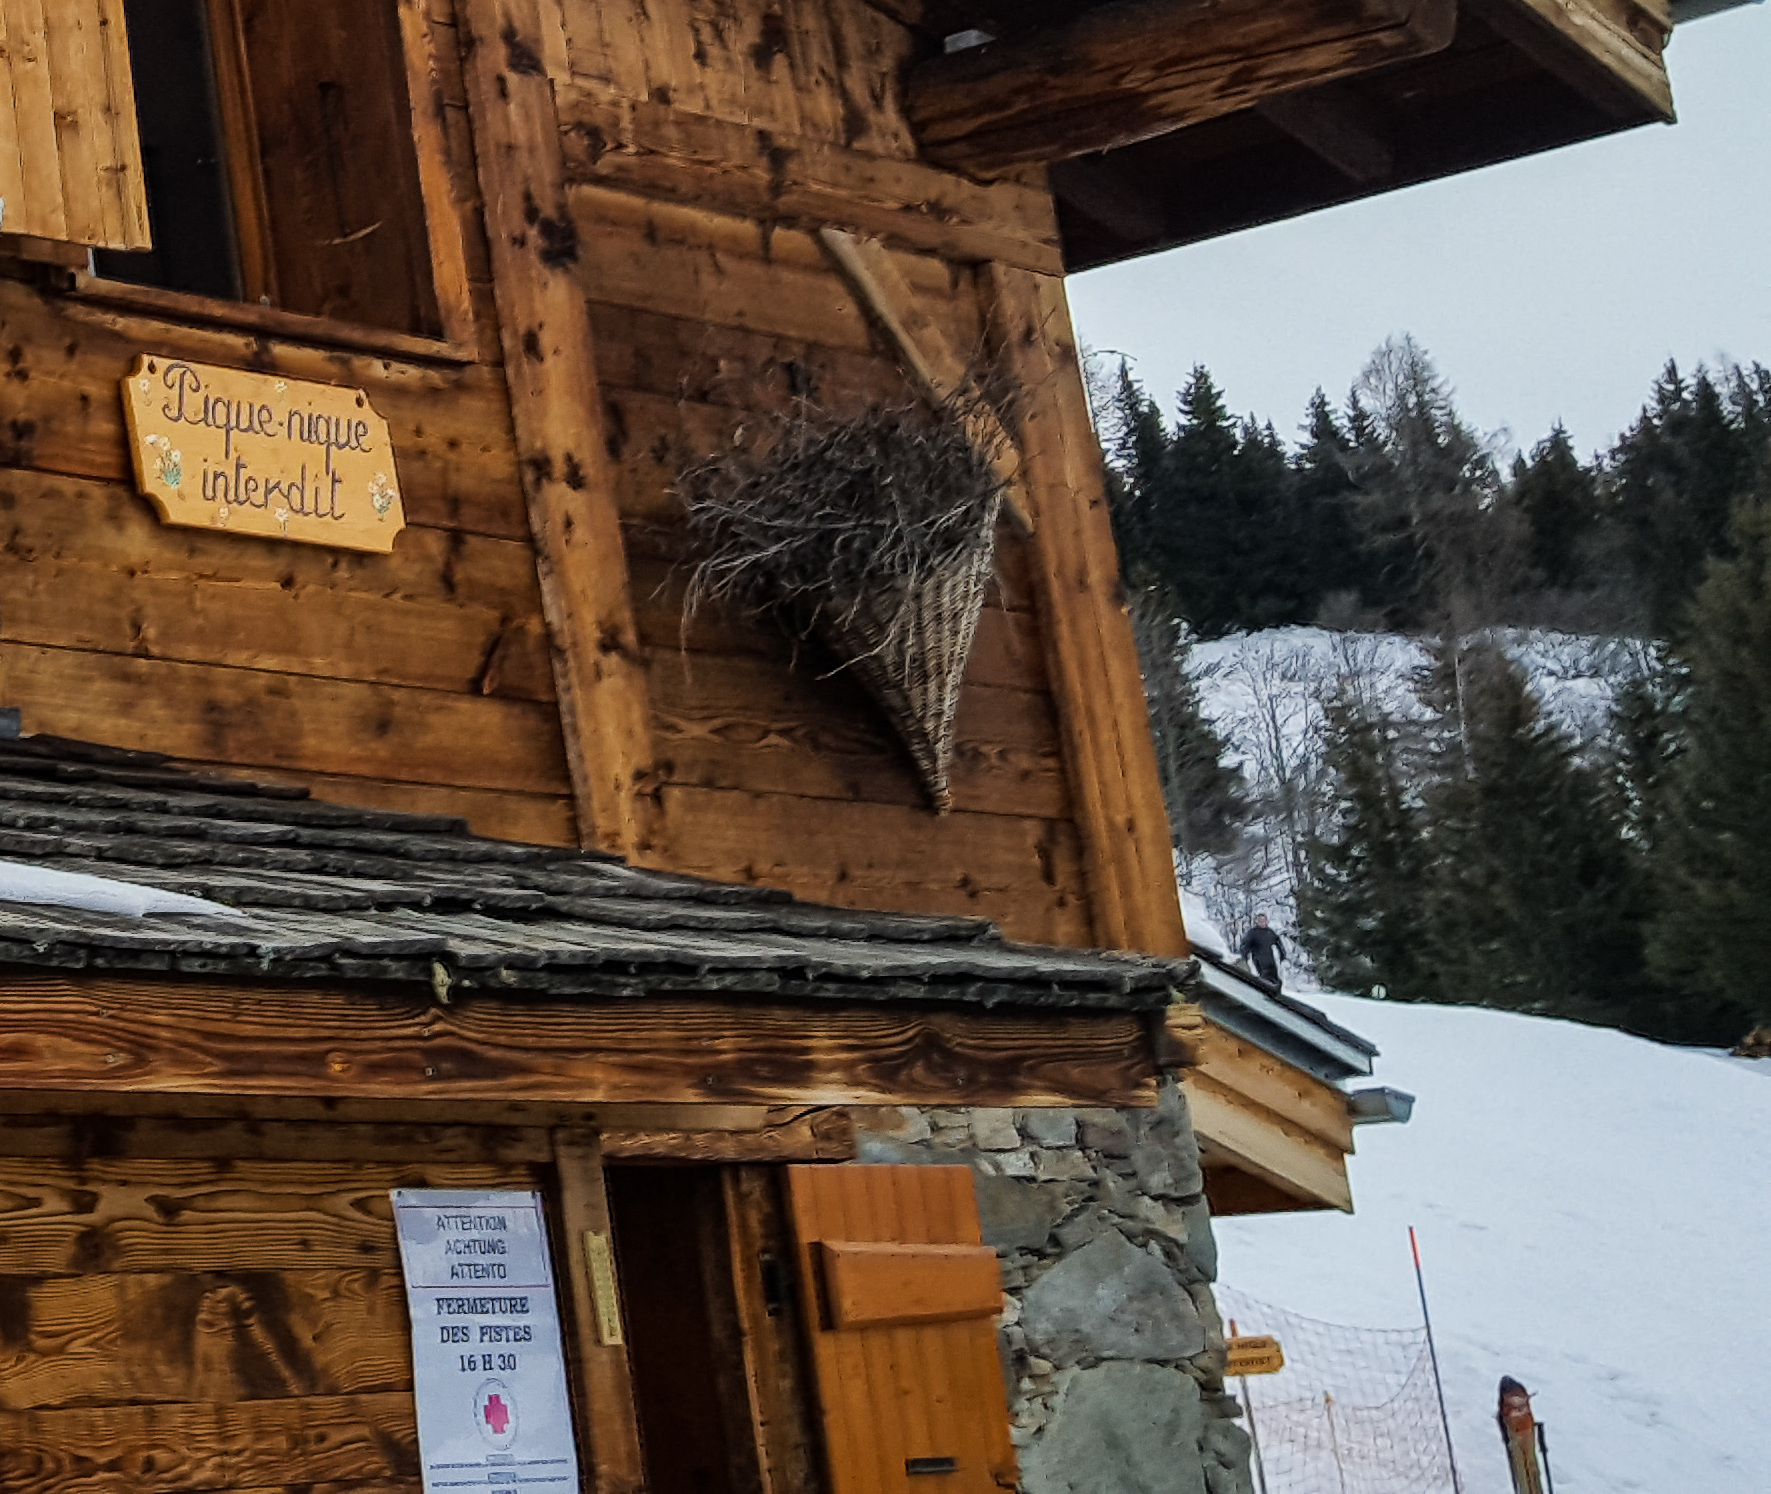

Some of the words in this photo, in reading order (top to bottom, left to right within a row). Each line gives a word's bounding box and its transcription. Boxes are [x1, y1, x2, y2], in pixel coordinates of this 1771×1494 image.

[162, 362, 373, 476] Pique-nique
[201, 455, 346, 521] interdit
[436, 1214, 508, 1232] ATTENTION
[444, 1238, 508, 1255] ACHTUNG
[434, 1296, 531, 1316] FERMETURE
[440, 1325, 471, 1344] DES
[479, 1324, 533, 1344] PISTES
[460, 1354, 477, 1373] 16
[497, 1353, 518, 1372] 30
